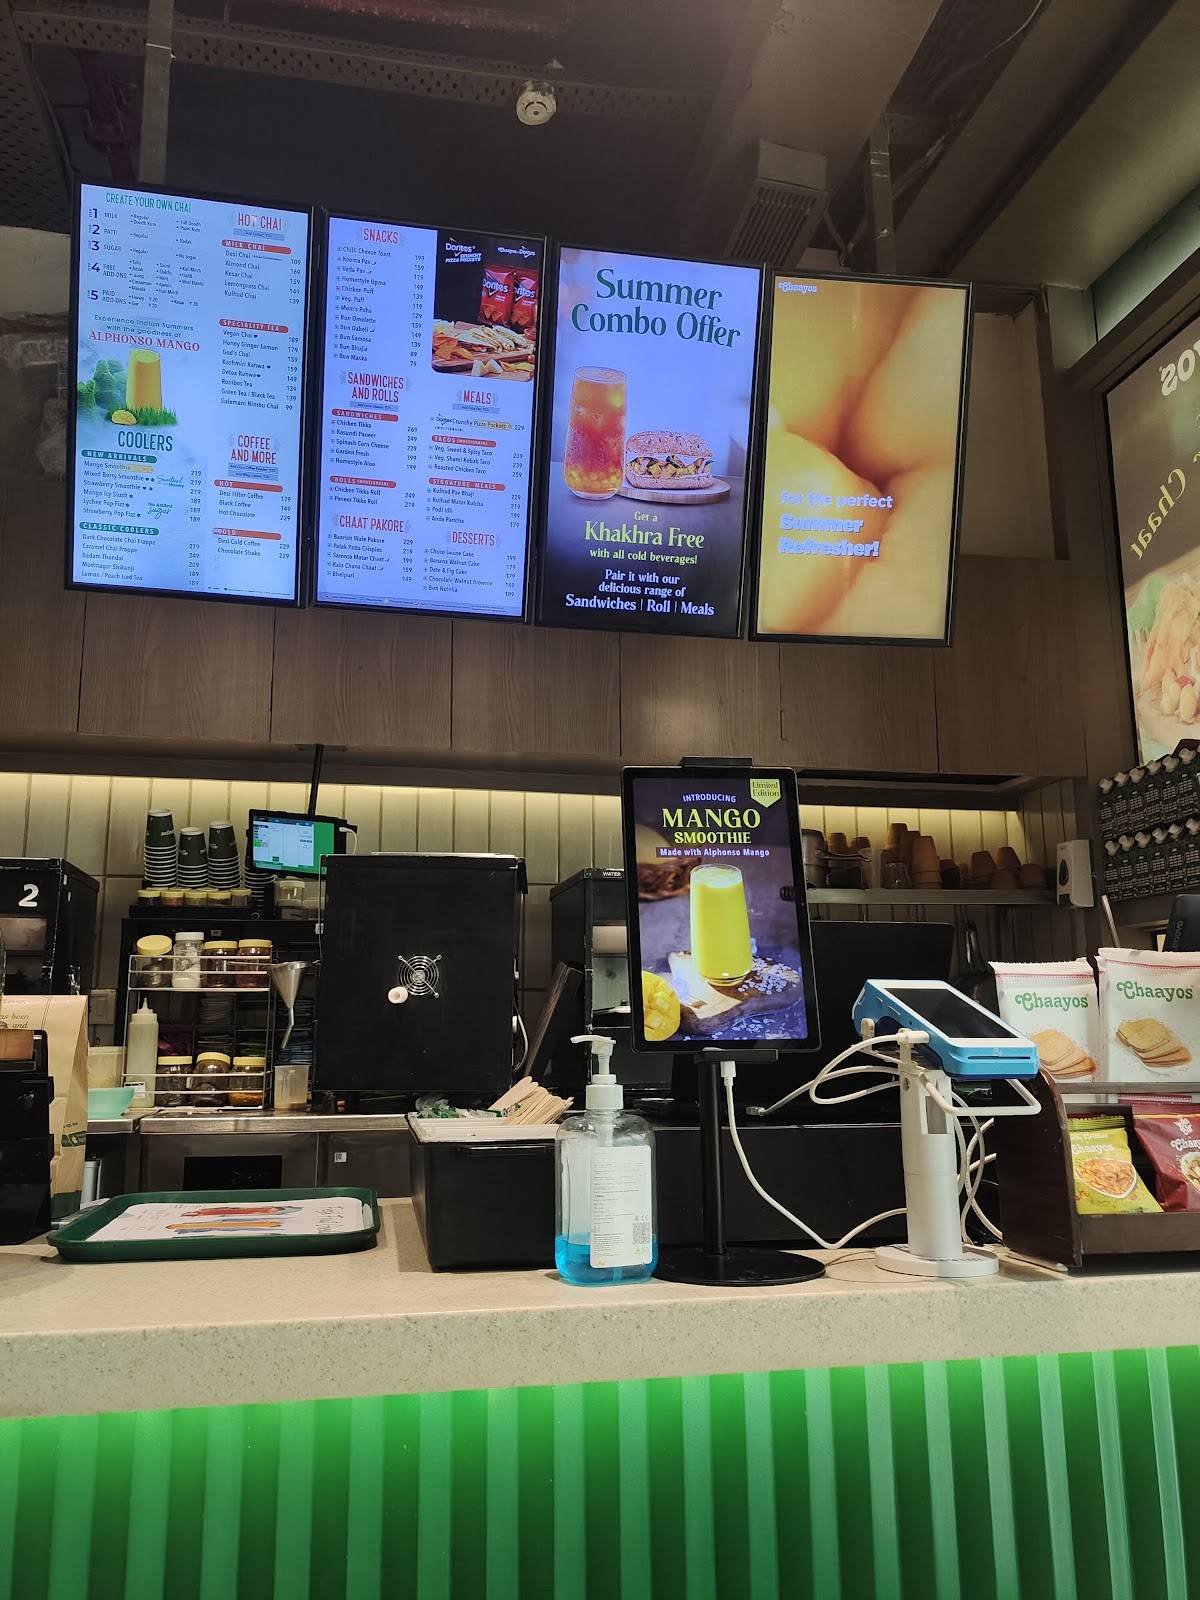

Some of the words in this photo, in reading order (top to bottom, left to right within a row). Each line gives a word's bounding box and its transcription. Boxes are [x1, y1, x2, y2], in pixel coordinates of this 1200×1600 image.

[106, 193, 132, 205] CREATE
[136, 197, 155, 208] YOUR
[157, 200, 172, 209] OWN
[175, 201, 191, 213] CHAI
[93, 209, 98, 218] 1
[93, 225, 100, 234] 2
[238, 213, 257, 227] HOT
[260, 216, 282, 231] CHAI
[363, 228, 399, 244] SNACKS
[92, 241, 99, 251] 3
[445, 243, 473, 253] Doritos
[92, 263, 100, 272] 4
[483, 278, 508, 293] Doritos
[596, 268, 723, 310] Summer
[91, 290, 98, 300] 5
[94, 314, 134, 324] Experience
[137, 319, 160, 327] Indian
[162, 322, 194, 331] Summers
[571, 303, 666, 336] Combo
[676, 312, 741, 348] Offer
[137, 328, 171, 337] goodness
[89, 331, 153, 346] ALPHONSO
[156, 338, 200, 351] MANGO
[348, 372, 404, 389] SANDWICHES
[352, 387, 370, 400] AND
[372, 389, 399, 402] ROLLS
[464, 390, 492, 404] MEALS
[336, 410, 382, 420] SANDWICHES
[118, 430, 173, 450] COOLERS
[237, 434, 270, 450] COFFEE
[108, 452, 148, 462] ARRIVALS
[230, 449, 249, 462] AND
[251, 451, 276, 464] MORE
[808, 491, 832, 505] the
[837, 495, 893, 509] perfect
[340, 515, 368, 529] CHAAT
[370, 518, 404, 532] PAKORE
[634, 511, 649, 522] Get
[781, 514, 864, 533] Summer
[84, 523, 116, 531] CLASSIC
[120, 526, 154, 534] COOLERS
[584, 520, 663, 546] Khakhra
[668, 527, 705, 549] Free
[452, 531, 495, 546] DESSERTS
[779, 538, 880, 557] Refresher!
[590, 548, 610, 558] with
[613, 550, 624, 560] all
[628, 551, 647, 561] cold
[649, 553, 698, 565] beverages!
[604, 569, 626, 581] Pair
[628, 571, 636, 582] it
[638, 572, 659, 583] with
[662, 576, 680, 584] our
[598, 582, 641, 594] delicious
[644, 587, 672, 598] range
[675, 587, 687, 598] of
[565, 593, 636, 611] Sandwiches
[646, 599, 671, 613] Roll
[680, 601, 715, 616] Meals
[753, 780, 778, 789] Limited
[682, 793, 736, 803] INTRODUCING
[753, 789, 779, 797] Edition
[662, 808, 761, 828] MANGO
[674, 831, 752, 844] SMOOTHIE
[660, 848, 682, 856] Made
[684, 848, 702, 856] with
[704, 848, 740, 857] Alphonso
[743, 849, 770, 858] Mango
[18, 884, 39, 907] 2
[1116, 980, 1194, 1002] Chaayos
[1014, 992, 1089, 1012] Chaayos
[1170, 1137, 1200, 1152] Chaay
